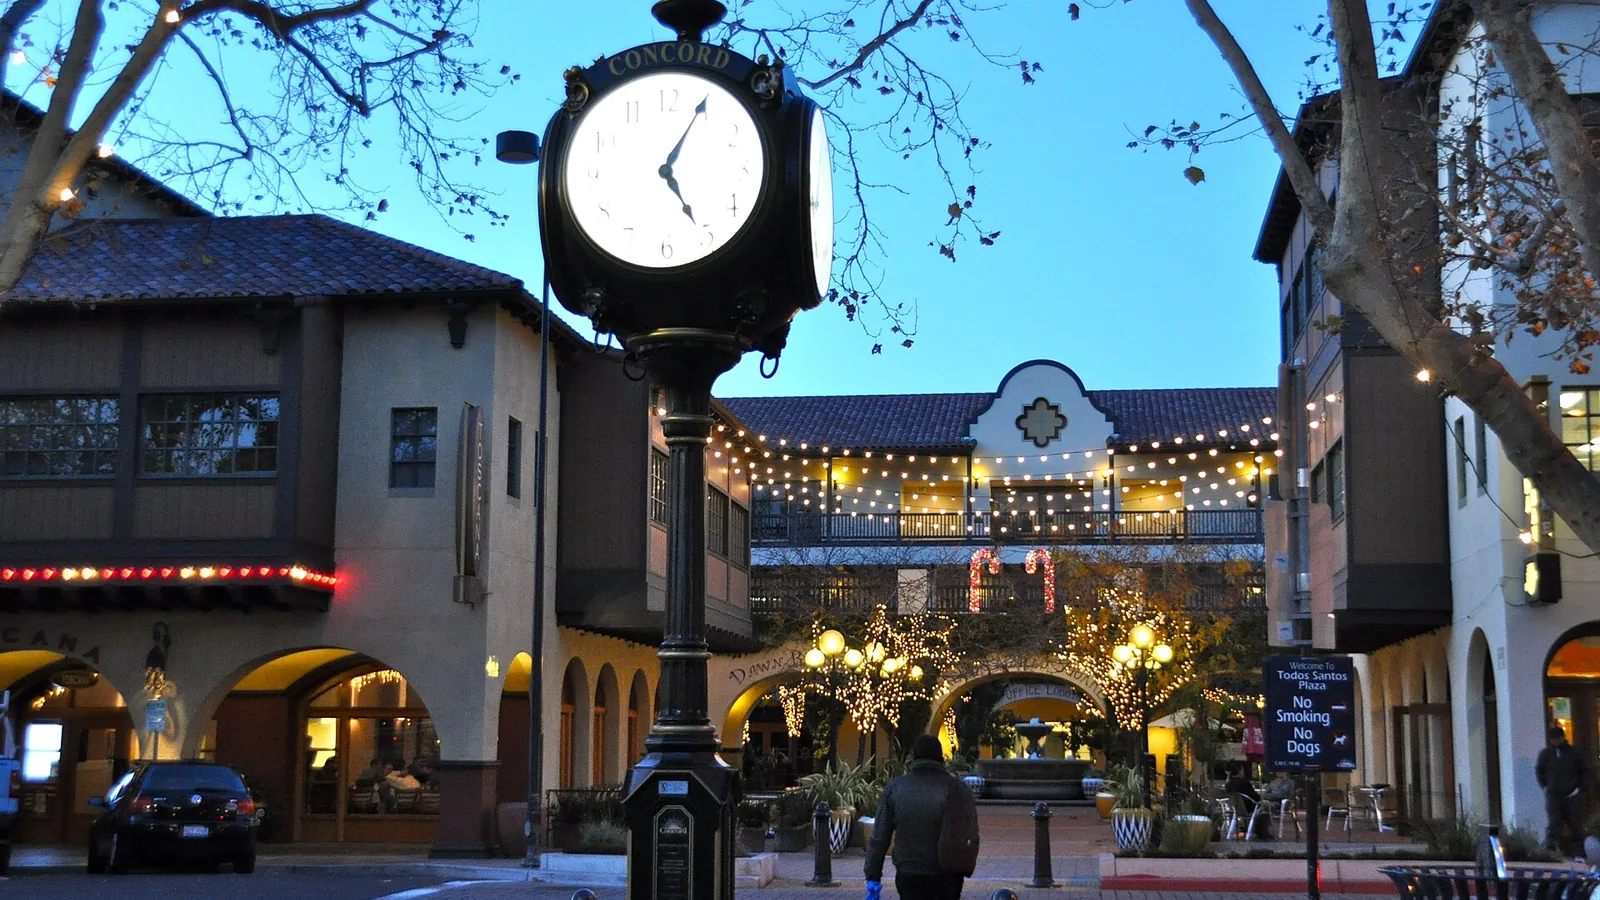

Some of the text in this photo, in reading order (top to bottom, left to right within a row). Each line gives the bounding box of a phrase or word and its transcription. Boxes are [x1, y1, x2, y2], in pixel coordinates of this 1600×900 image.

[608, 43, 730, 76] CONCORD
[660, 88, 680, 112] 12
[626, 100, 639, 124] 11
[728, 123, 741, 148] 2
[726, 193, 741, 218] 4
[661, 234, 674, 259] 6
[1289, 661, 1335, 670] Welcome To
[1277, 670, 1347, 680] Todos Santos
[1006, 684, 1040, 700] OFFICE
[1298, 680, 1326, 690] Plaza
[1293, 695, 1312, 709] No
[1276, 709, 1330, 727] Smoking
[1293, 726, 1313, 740] No
[1287, 740, 1320, 757] Dogs
